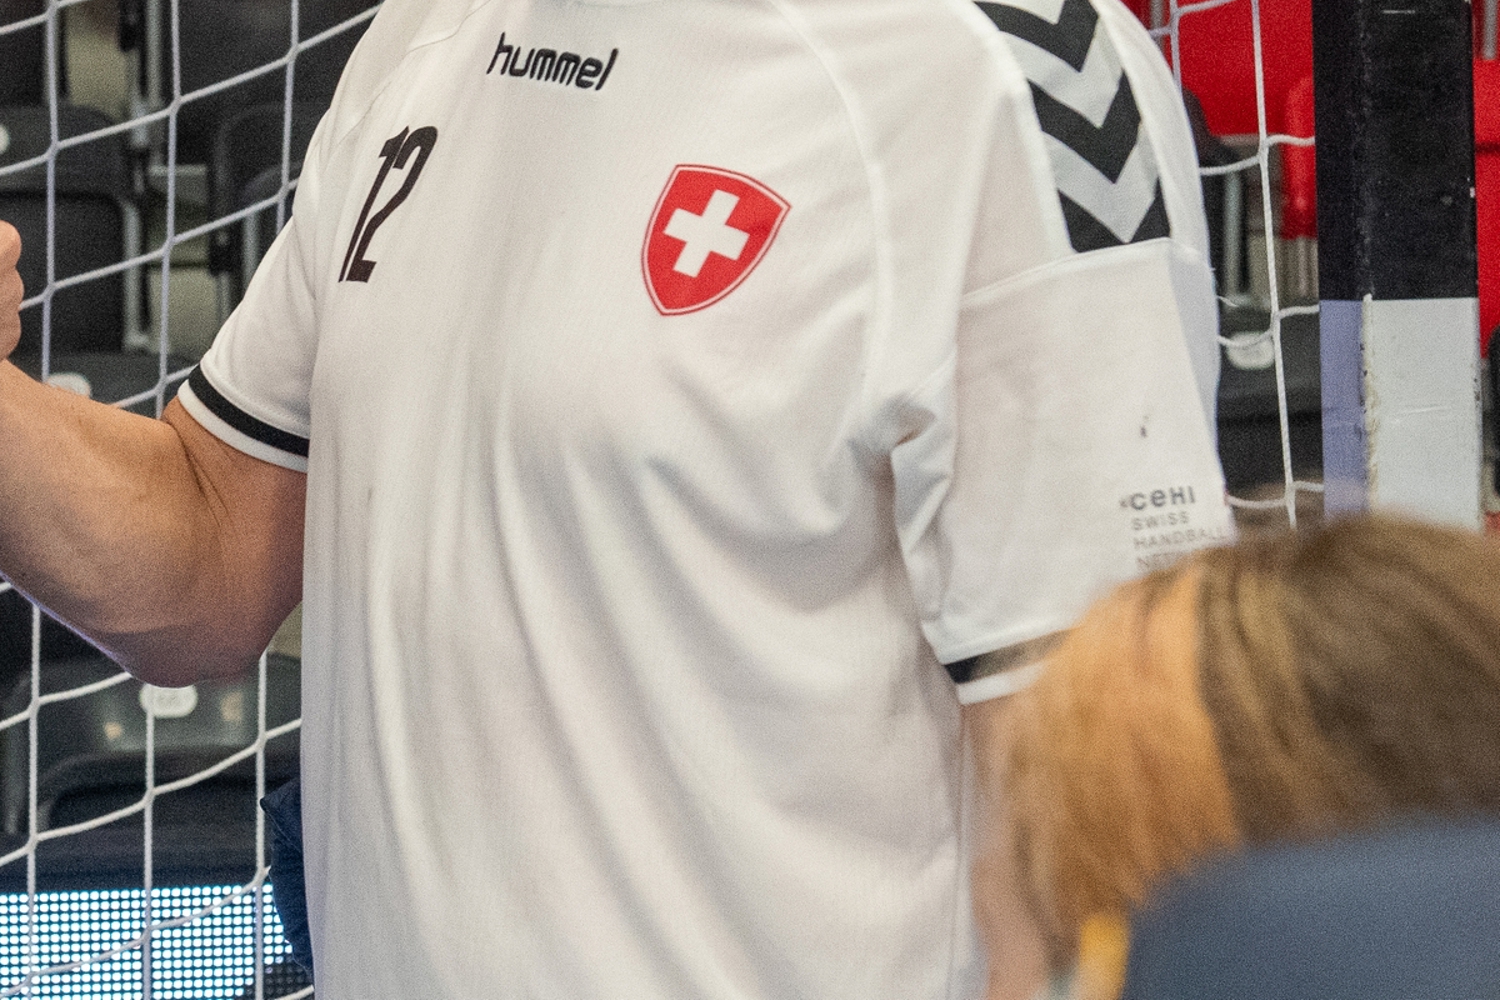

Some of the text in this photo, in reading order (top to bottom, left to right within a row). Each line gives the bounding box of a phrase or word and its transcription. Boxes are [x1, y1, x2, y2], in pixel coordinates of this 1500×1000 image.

[486, 32, 619, 91] hummel
[338, 125, 438, 283] 12
[1132, 511, 1189, 531] SWISS
